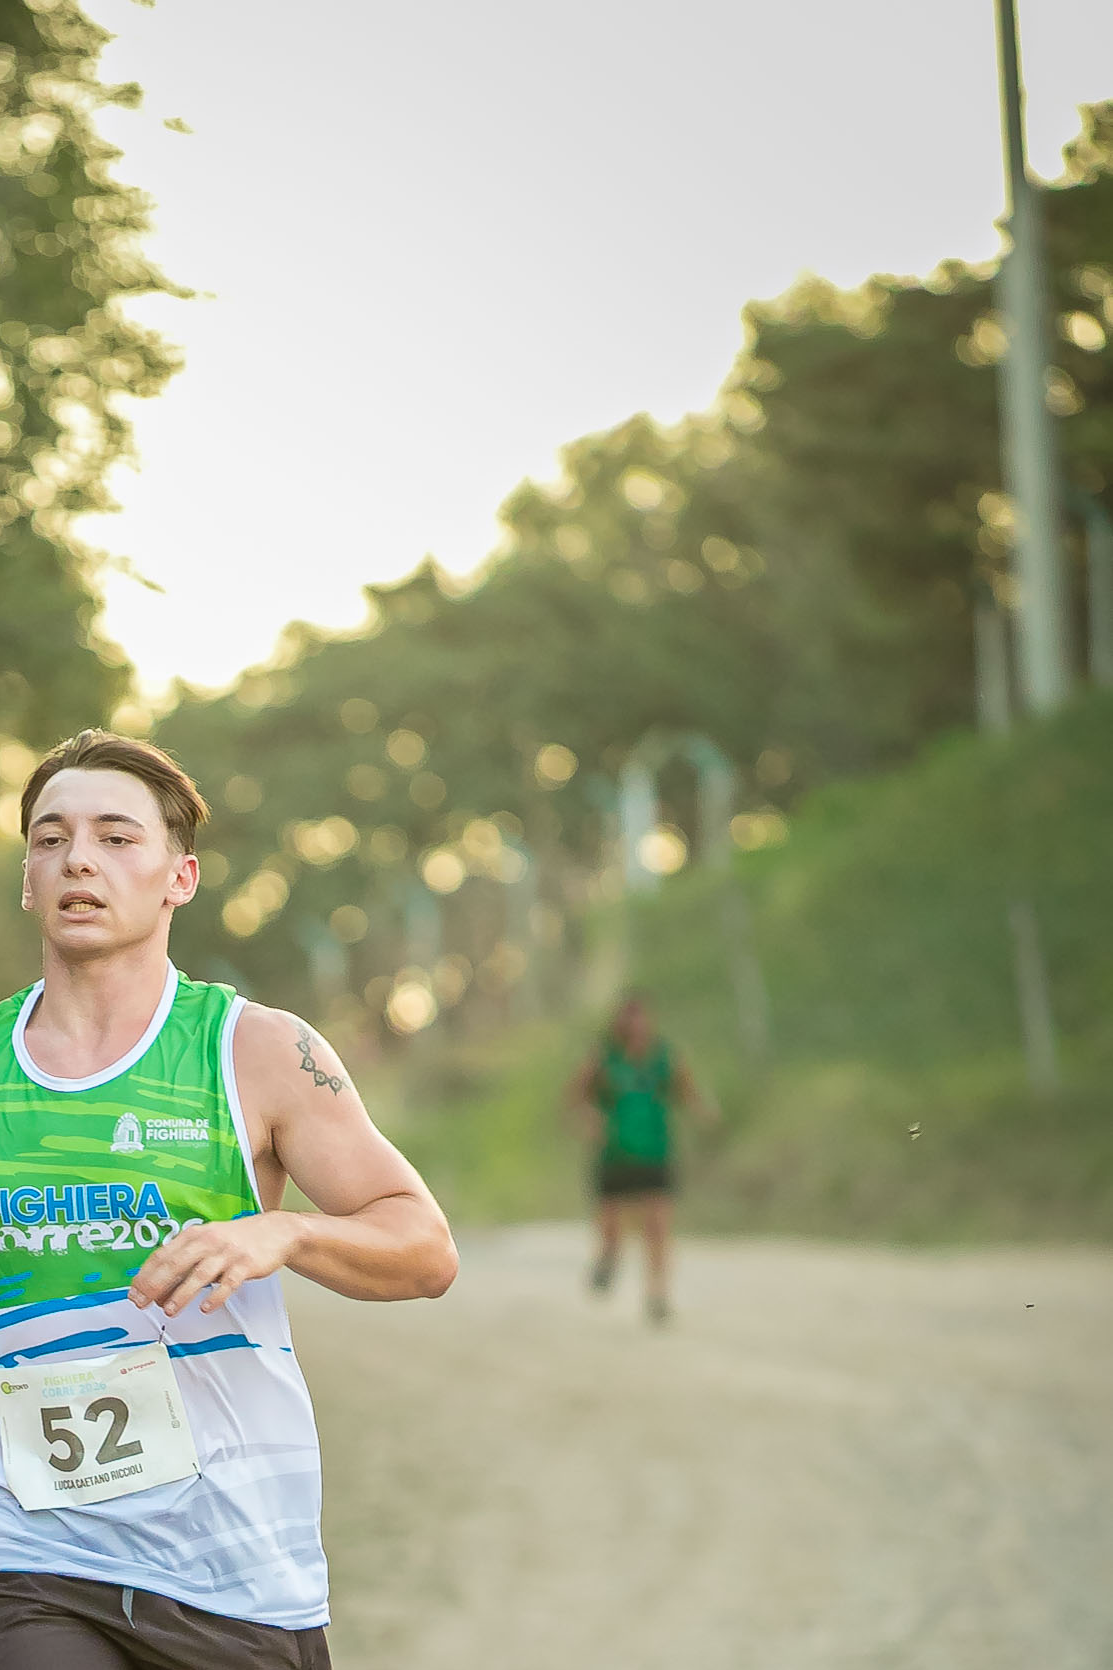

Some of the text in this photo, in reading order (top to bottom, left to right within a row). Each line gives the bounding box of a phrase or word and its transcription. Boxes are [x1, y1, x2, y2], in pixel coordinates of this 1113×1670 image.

[146, 1119, 210, 1128] COMUNA DE
[146, 1128, 209, 1141] FIGHIERA
[44, 1371, 95, 1387] FIGHIERA
[40, 1396, 144, 1473] 52
